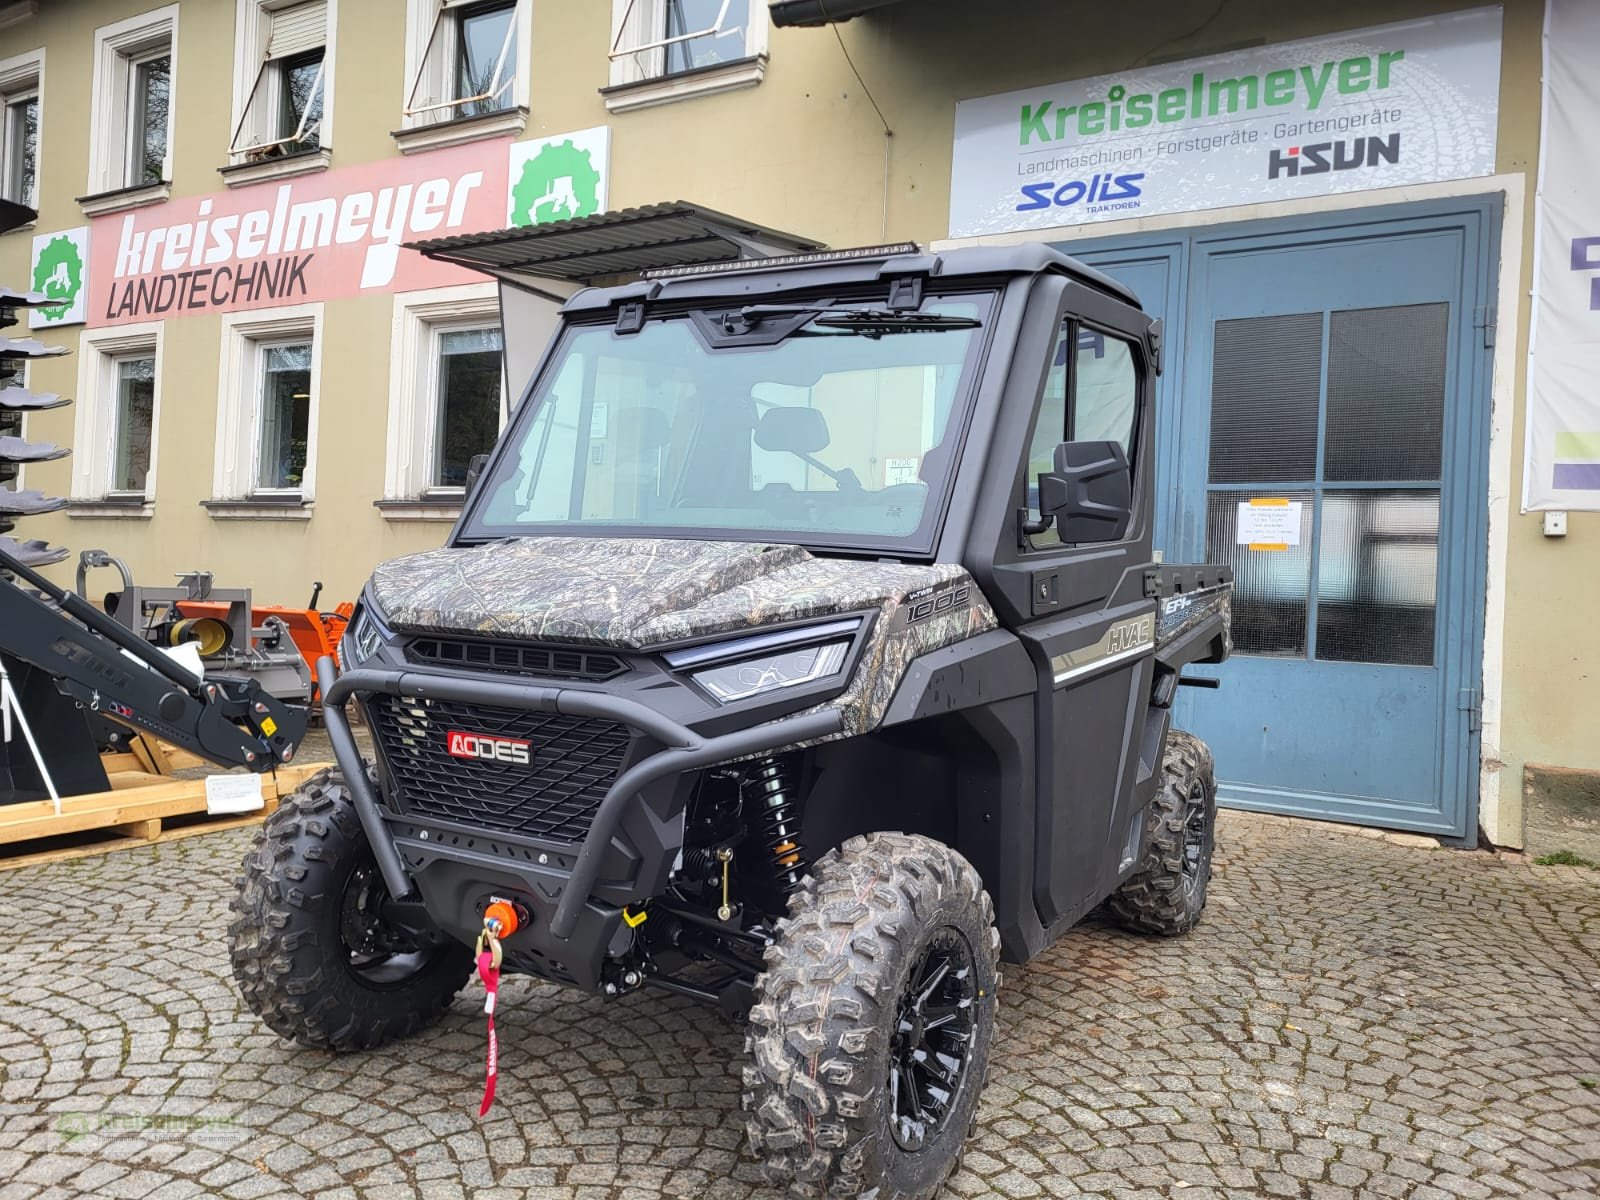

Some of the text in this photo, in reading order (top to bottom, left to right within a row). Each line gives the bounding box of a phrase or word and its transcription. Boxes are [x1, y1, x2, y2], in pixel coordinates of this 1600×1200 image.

[1019, 49, 1405, 145] Kreiselmeyer
[1017, 108, 1402, 176] Landmaschinen Forstgeräte Gartengeräte
[114, 170, 484, 288] kreiselmeyer
[1086, 200, 1141, 215] TRAKTOREN
[106, 253, 314, 320] LANDTECHNIK
[906, 584, 971, 625] 1000
[1106, 619, 1150, 655] HVAC
